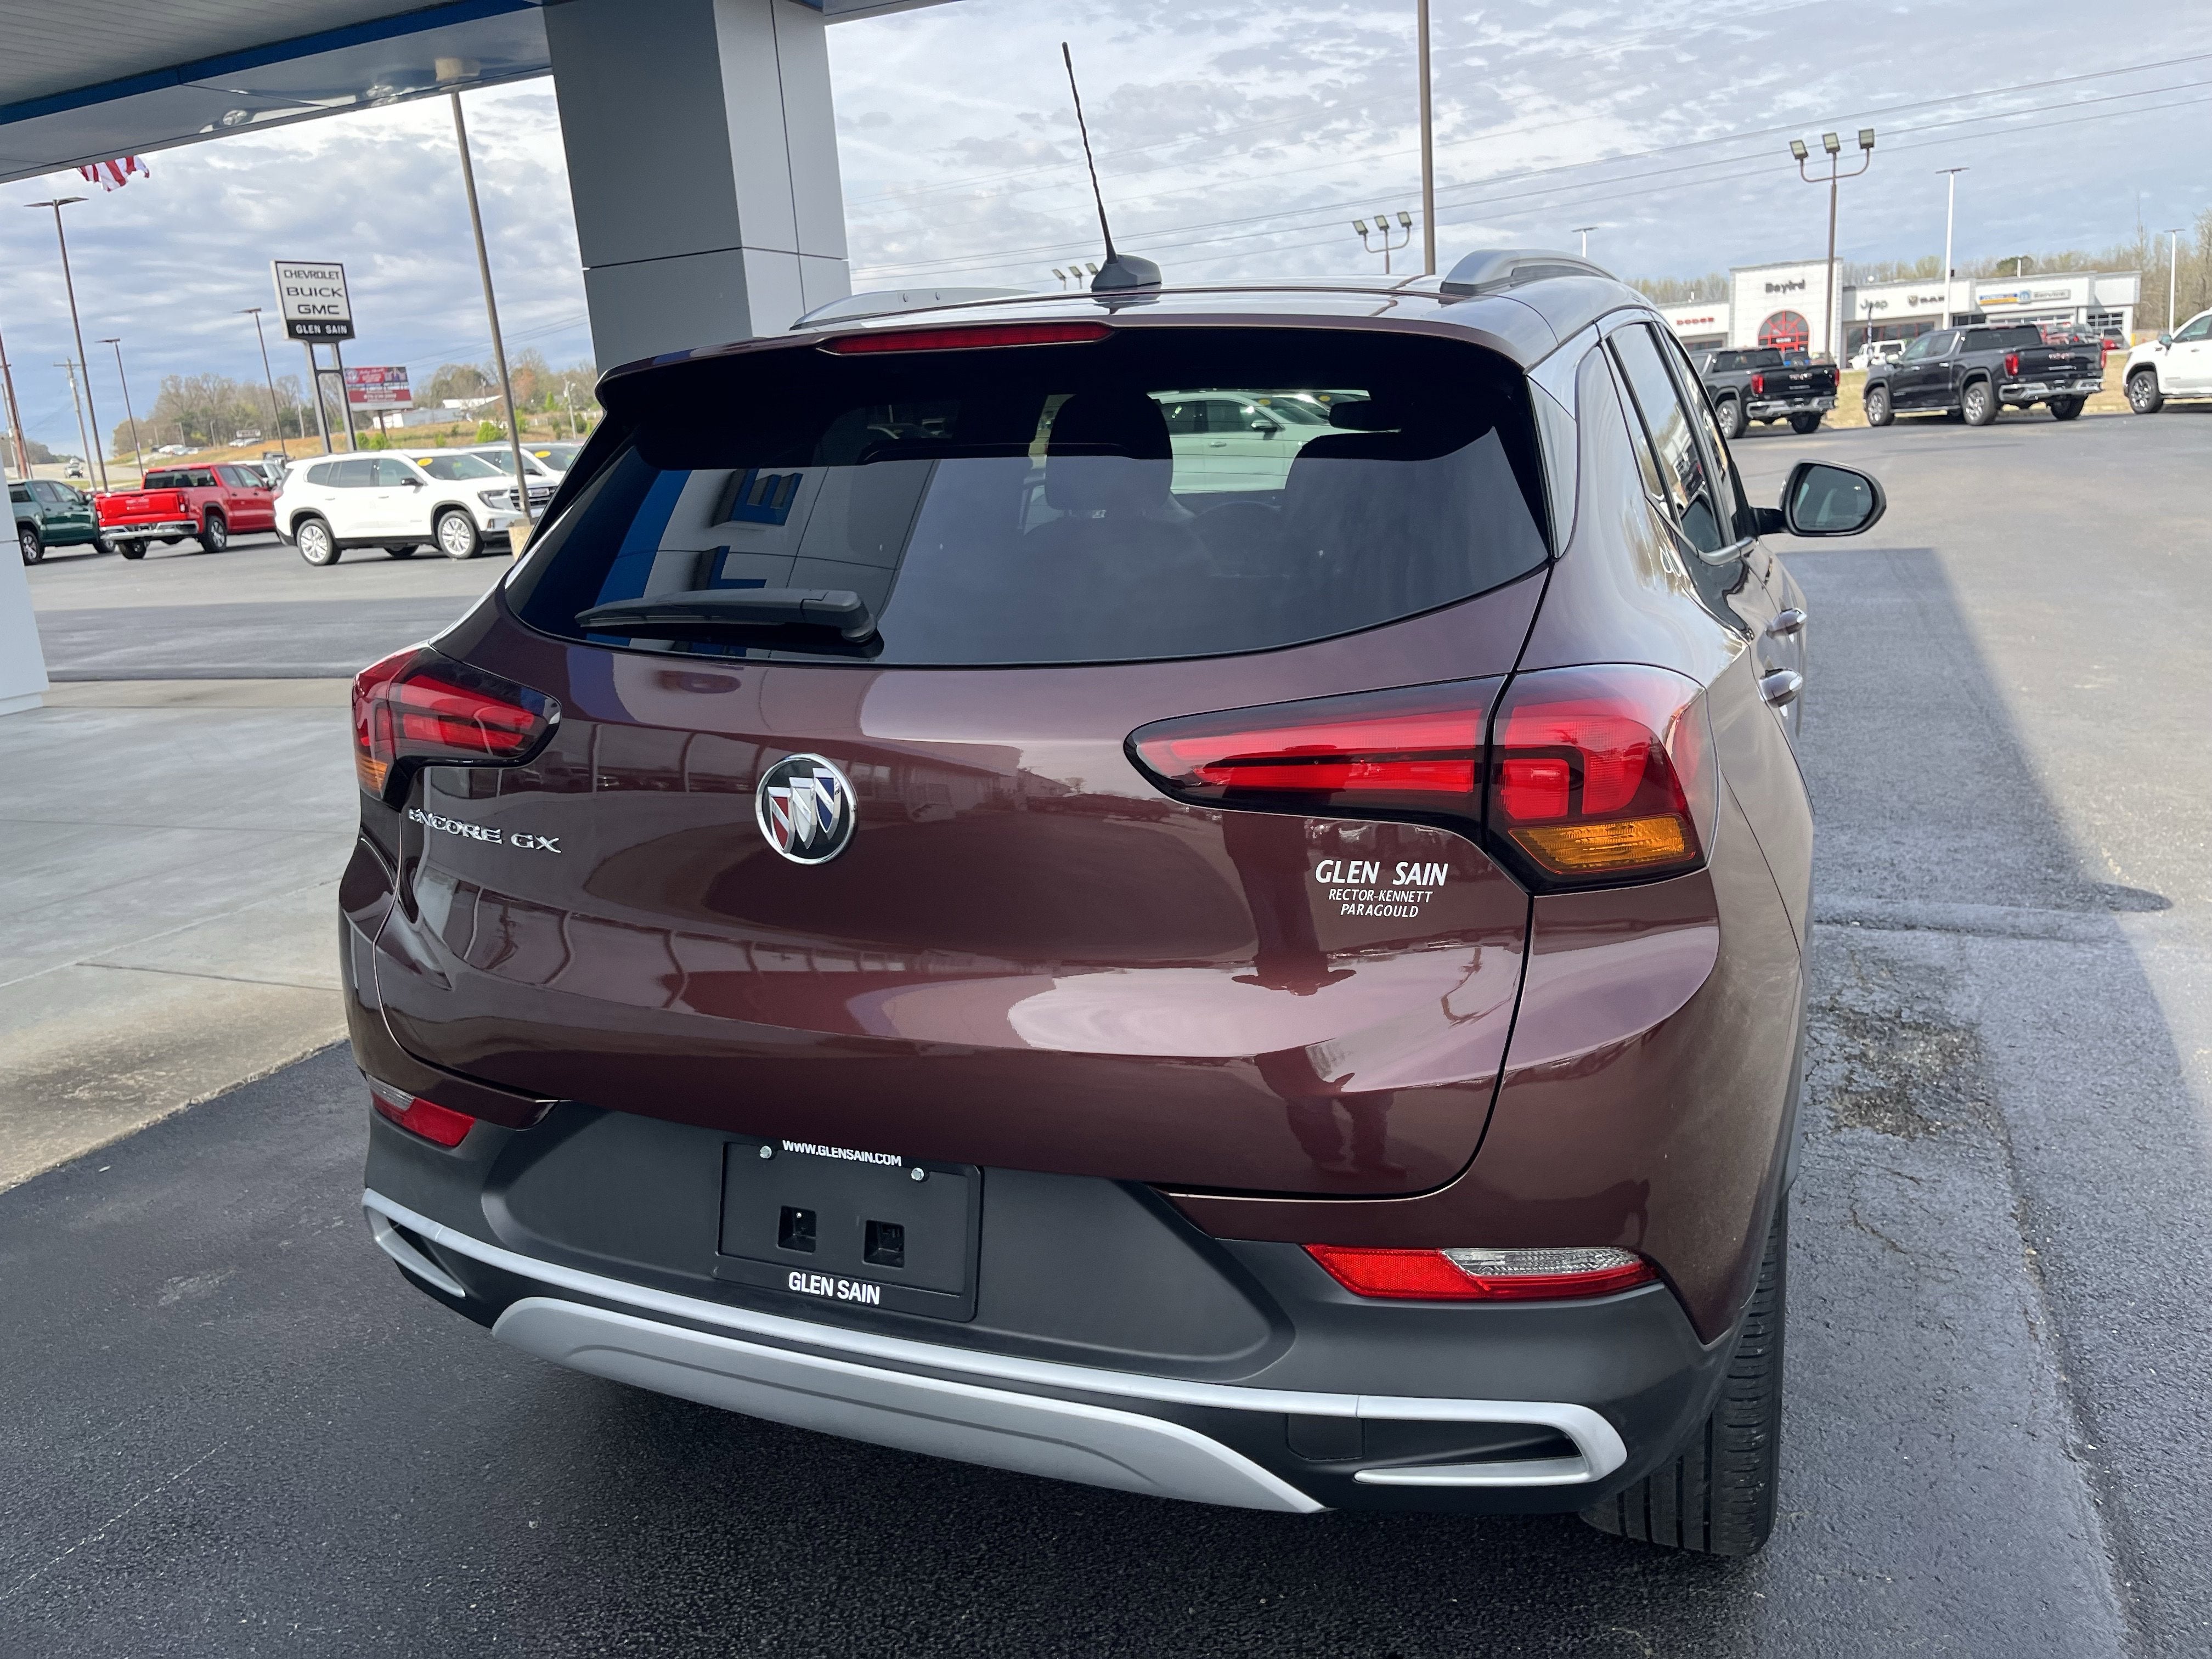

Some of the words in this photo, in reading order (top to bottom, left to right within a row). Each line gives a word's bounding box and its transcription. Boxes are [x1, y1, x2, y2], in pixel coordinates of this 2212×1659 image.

[284, 269, 339, 280] CHEVROLET
[286, 287, 343, 297] BUICK
[298, 304, 340, 315] GMC
[295, 324, 321, 334] GLEN
[326, 324, 347, 334] SAIN
[409, 809, 503, 844] ENCORE
[511, 833, 561, 853] GX
[1315, 859, 1380, 884] GLEN
[1392, 861, 1448, 886] SAIN
[1328, 888, 1433, 903] RECTOR-KENNETT
[1340, 904, 1419, 917] PARAGOULD
[782, 1139, 902, 1167] WWW.GLENSAIN.COM
[788, 1271, 834, 1297] GLEN
[837, 1280, 880, 1305] SAIN
